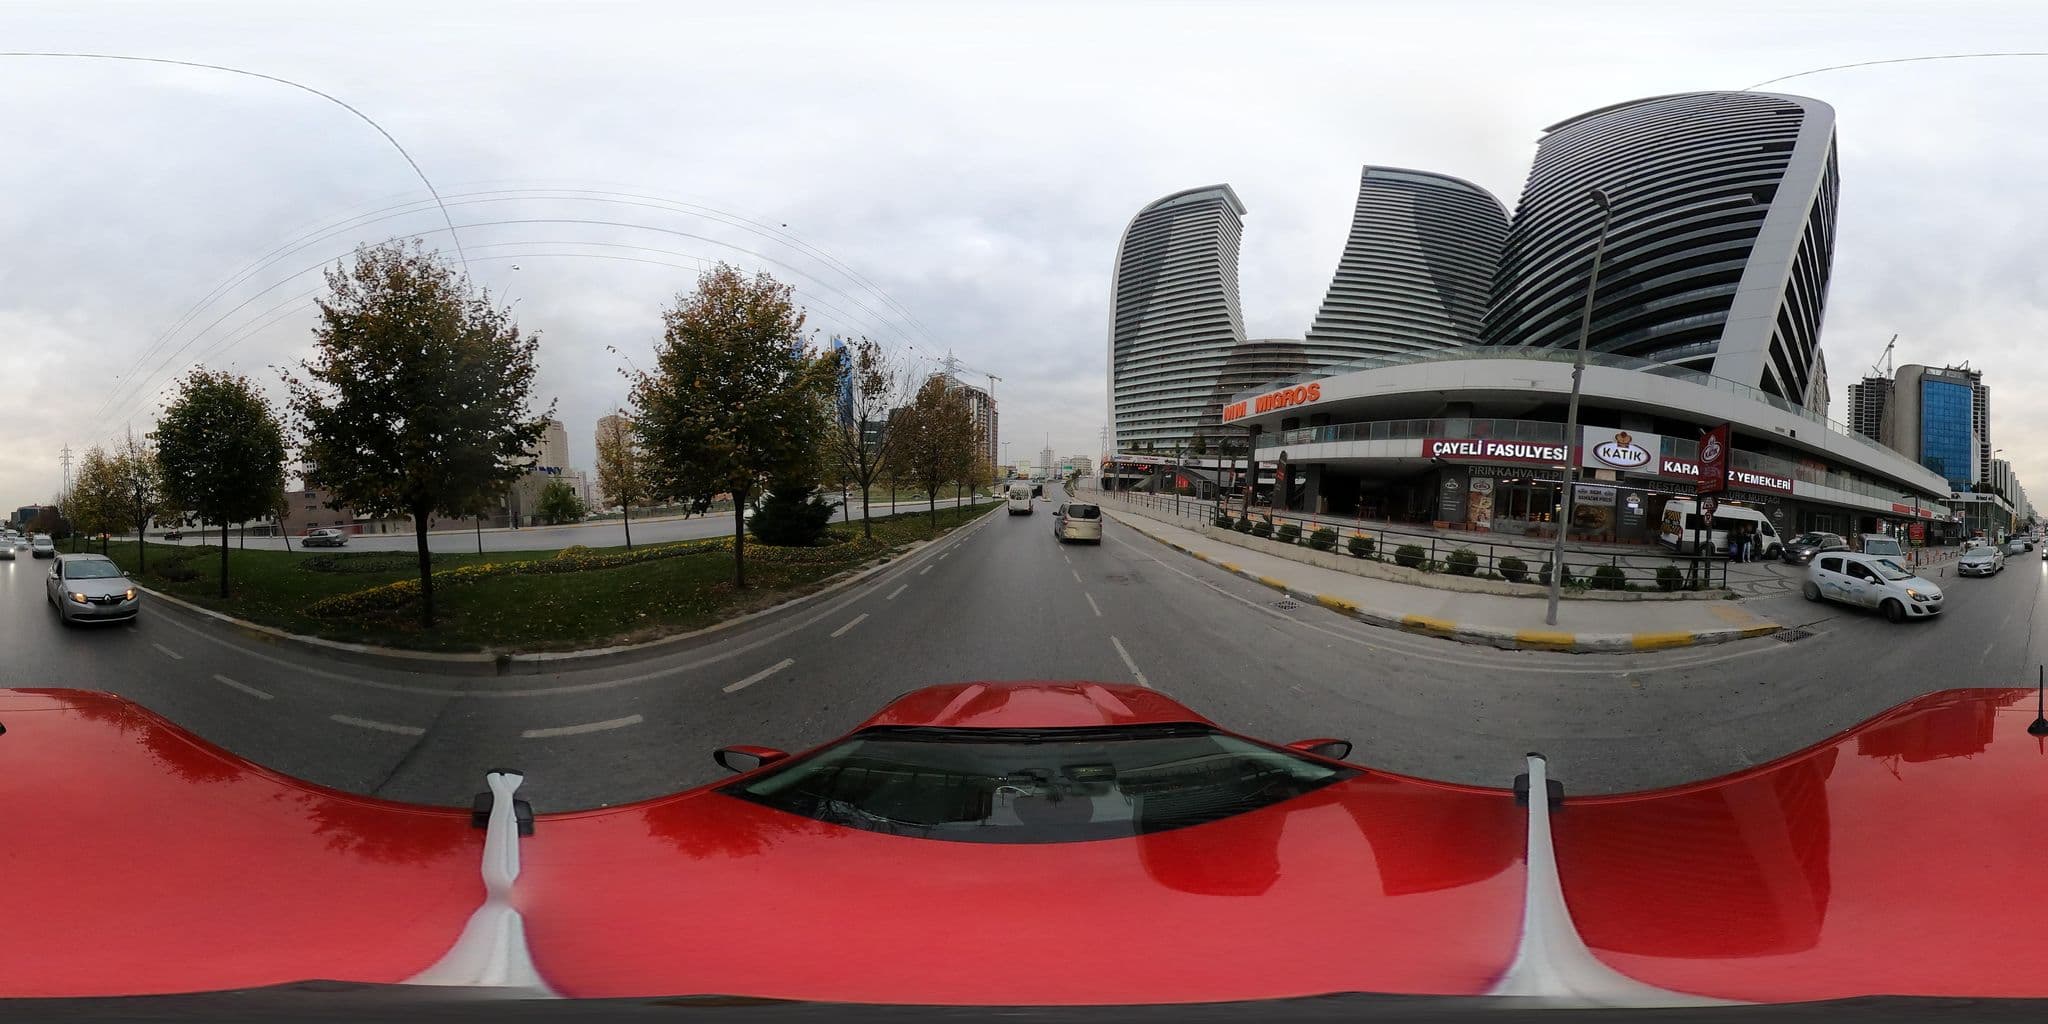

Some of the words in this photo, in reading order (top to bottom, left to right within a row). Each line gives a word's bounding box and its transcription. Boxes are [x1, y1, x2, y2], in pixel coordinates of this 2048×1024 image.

[1433, 440, 1482, 456] ÇAYELİ
[1487, 444, 1568, 461] FASULYESİ
[1603, 448, 1642, 461] KATIK
[1738, 472, 1791, 490] YEMEKLERİ
